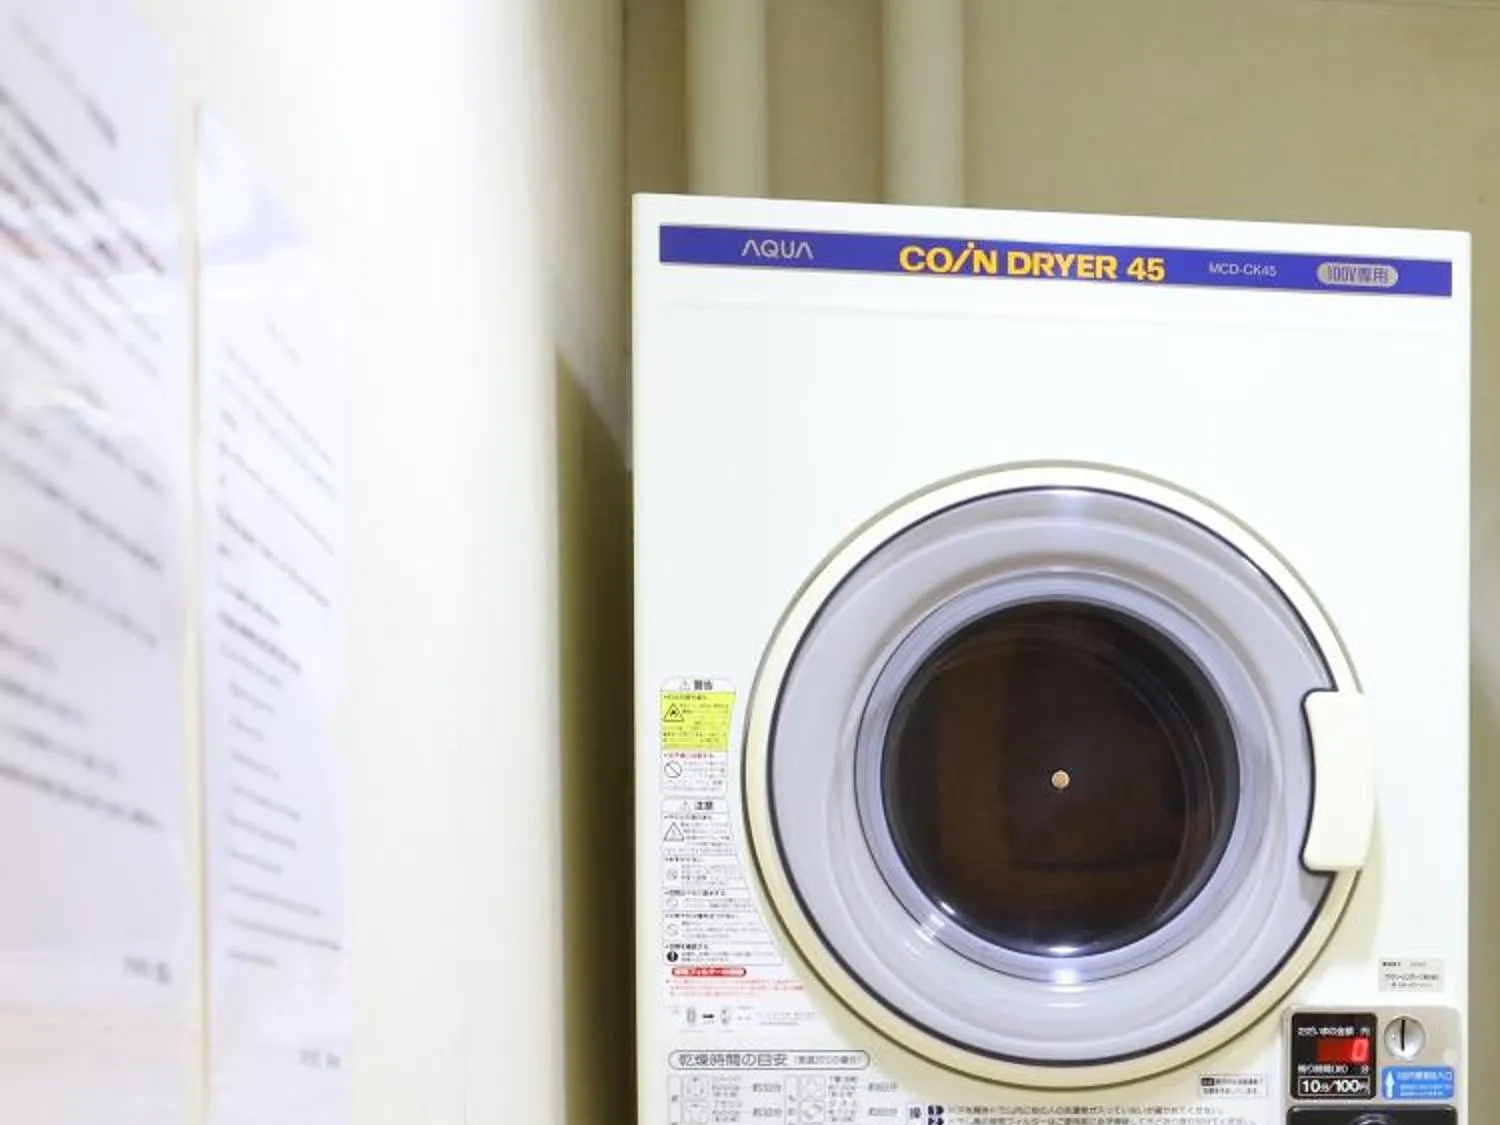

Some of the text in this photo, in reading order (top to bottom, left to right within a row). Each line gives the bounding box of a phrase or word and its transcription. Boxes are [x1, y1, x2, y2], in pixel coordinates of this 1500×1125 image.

[741, 240, 814, 261] AQUA
[1006, 250, 1117, 282] DRYER
[1127, 255, 1166, 283] 45
[1208, 261, 1278, 278] MCD-CK45
[1351, 1037, 1370, 1062] 0
[678, 1053, 789, 1068] 乾燥時間の目安
